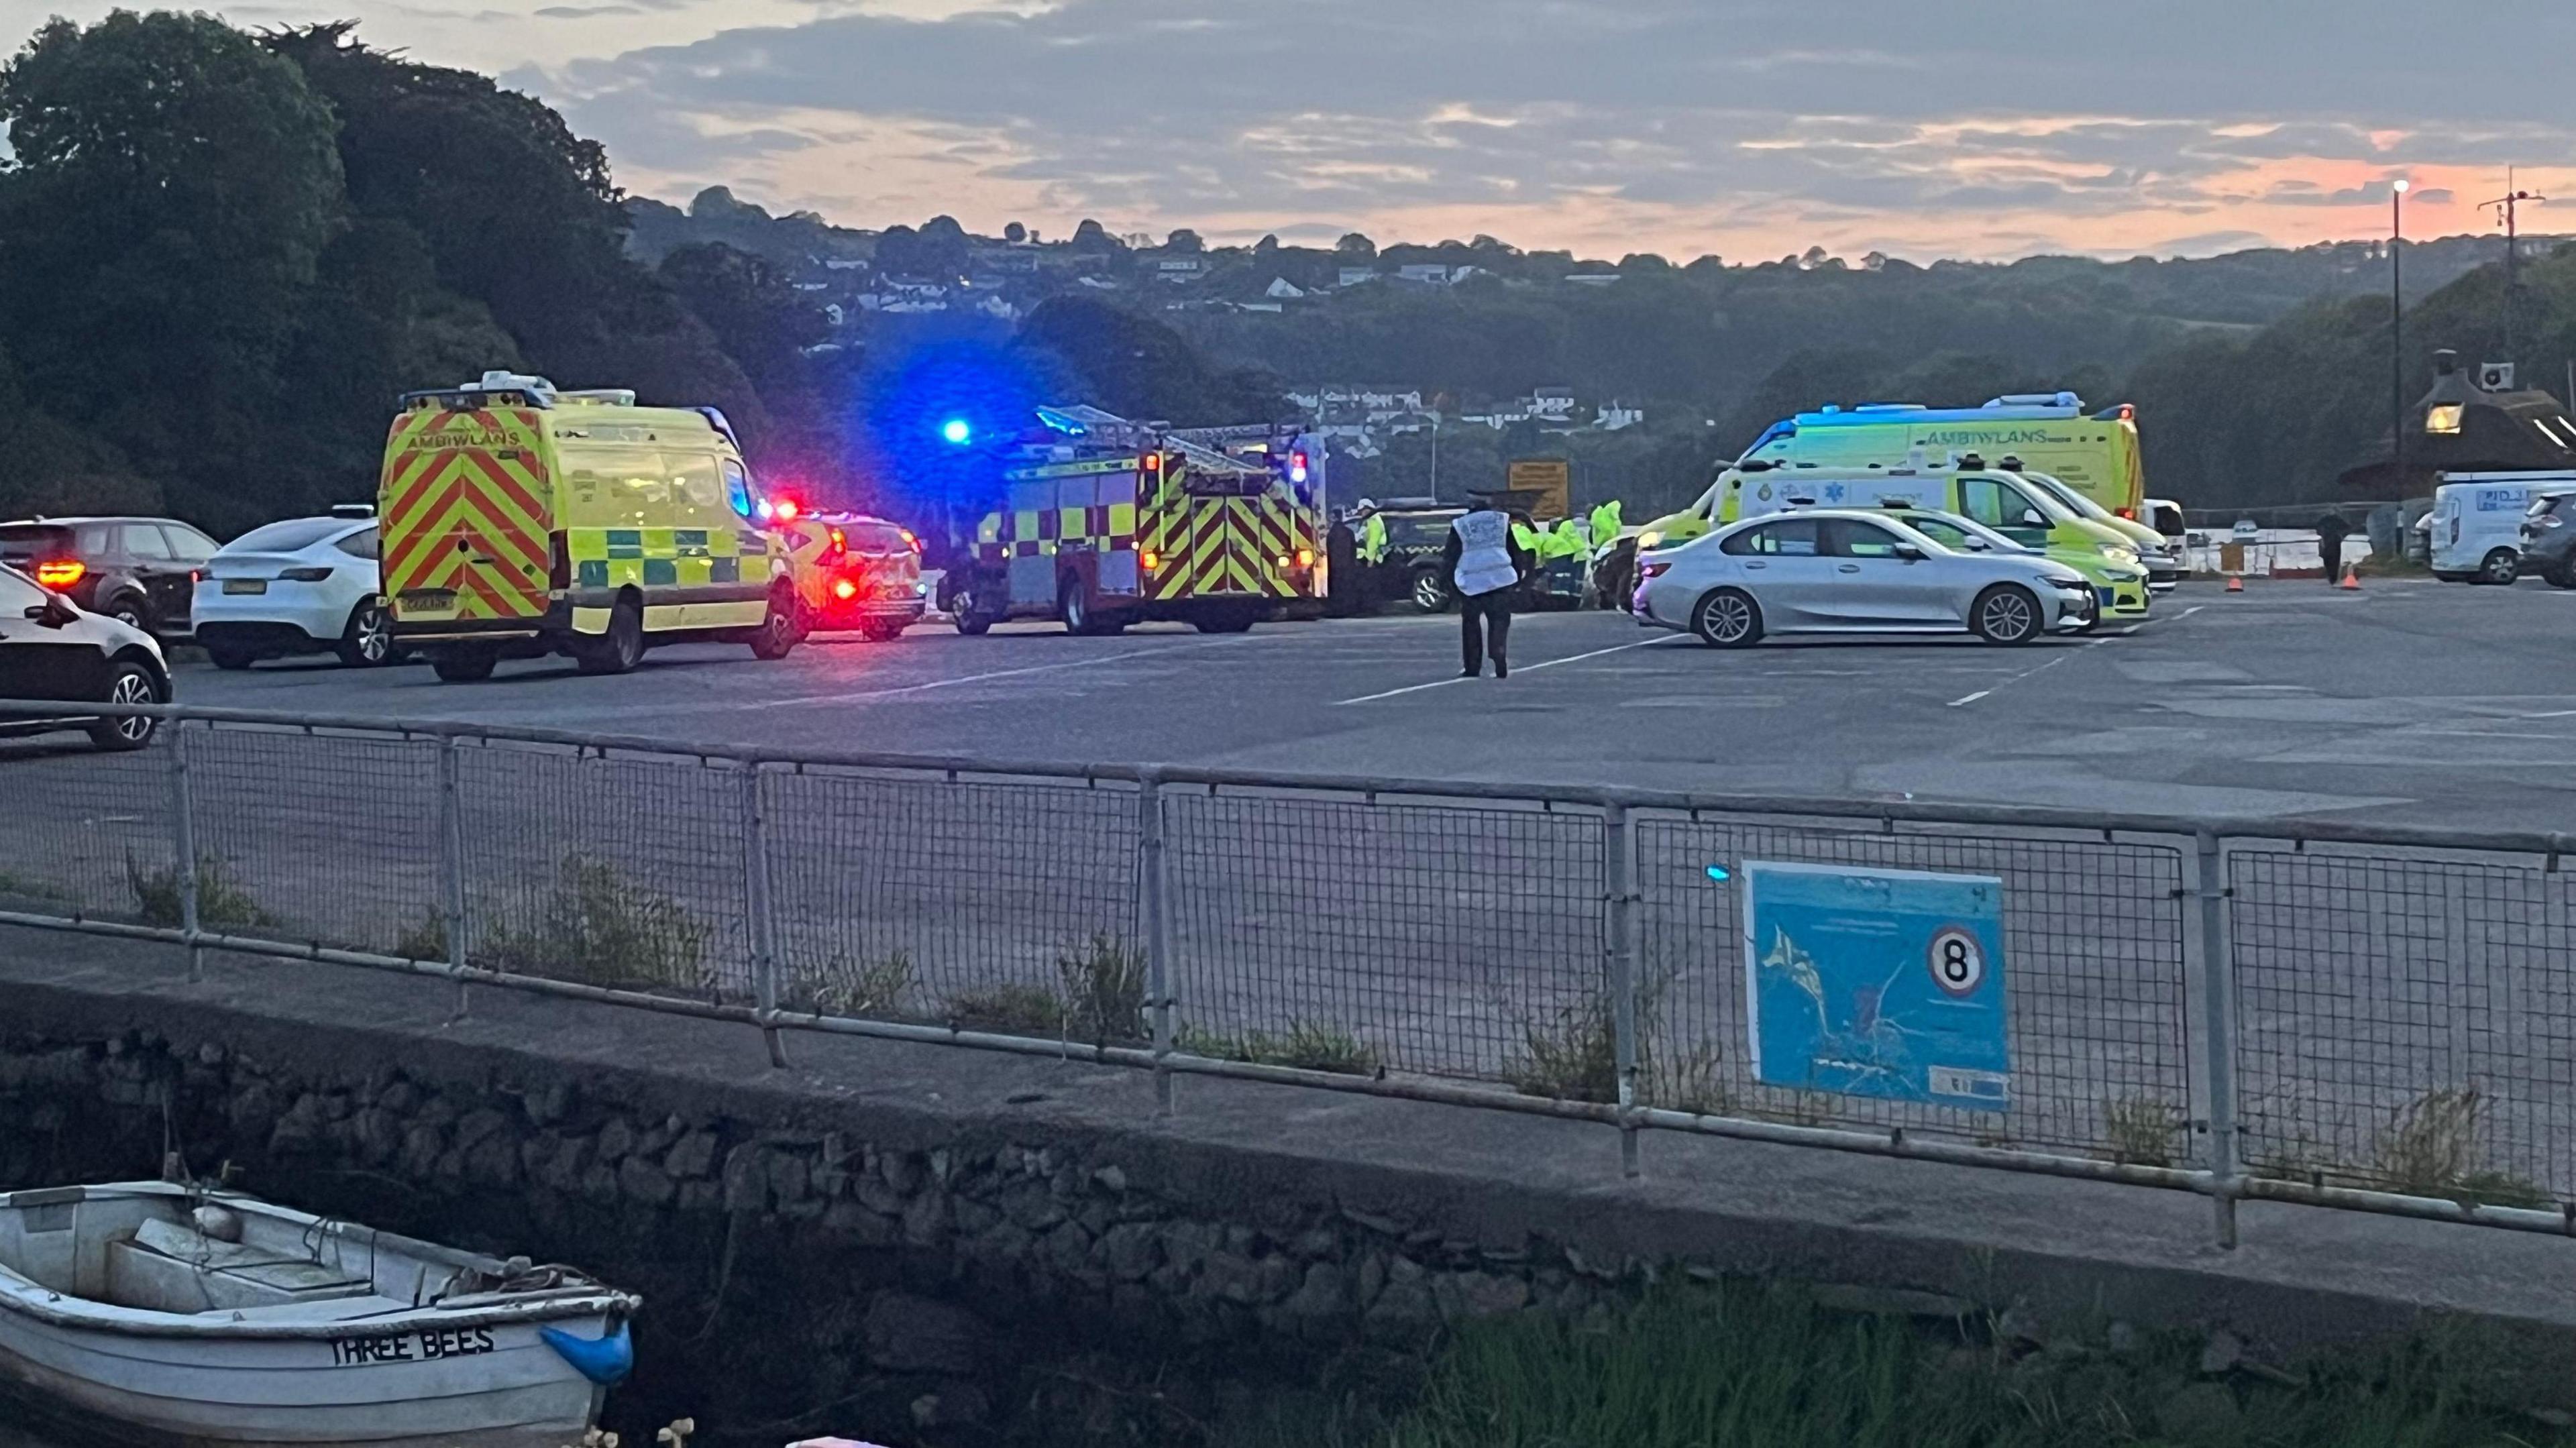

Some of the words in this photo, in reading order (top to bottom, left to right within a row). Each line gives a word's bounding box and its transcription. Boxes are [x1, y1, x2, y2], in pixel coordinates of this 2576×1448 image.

[407, 432, 521, 449] AMBIWLANS
[1944, 939, 1968, 982] 8
[333, 1335, 413, 1366] THREE
[420, 1327, 494, 1358] BEES
